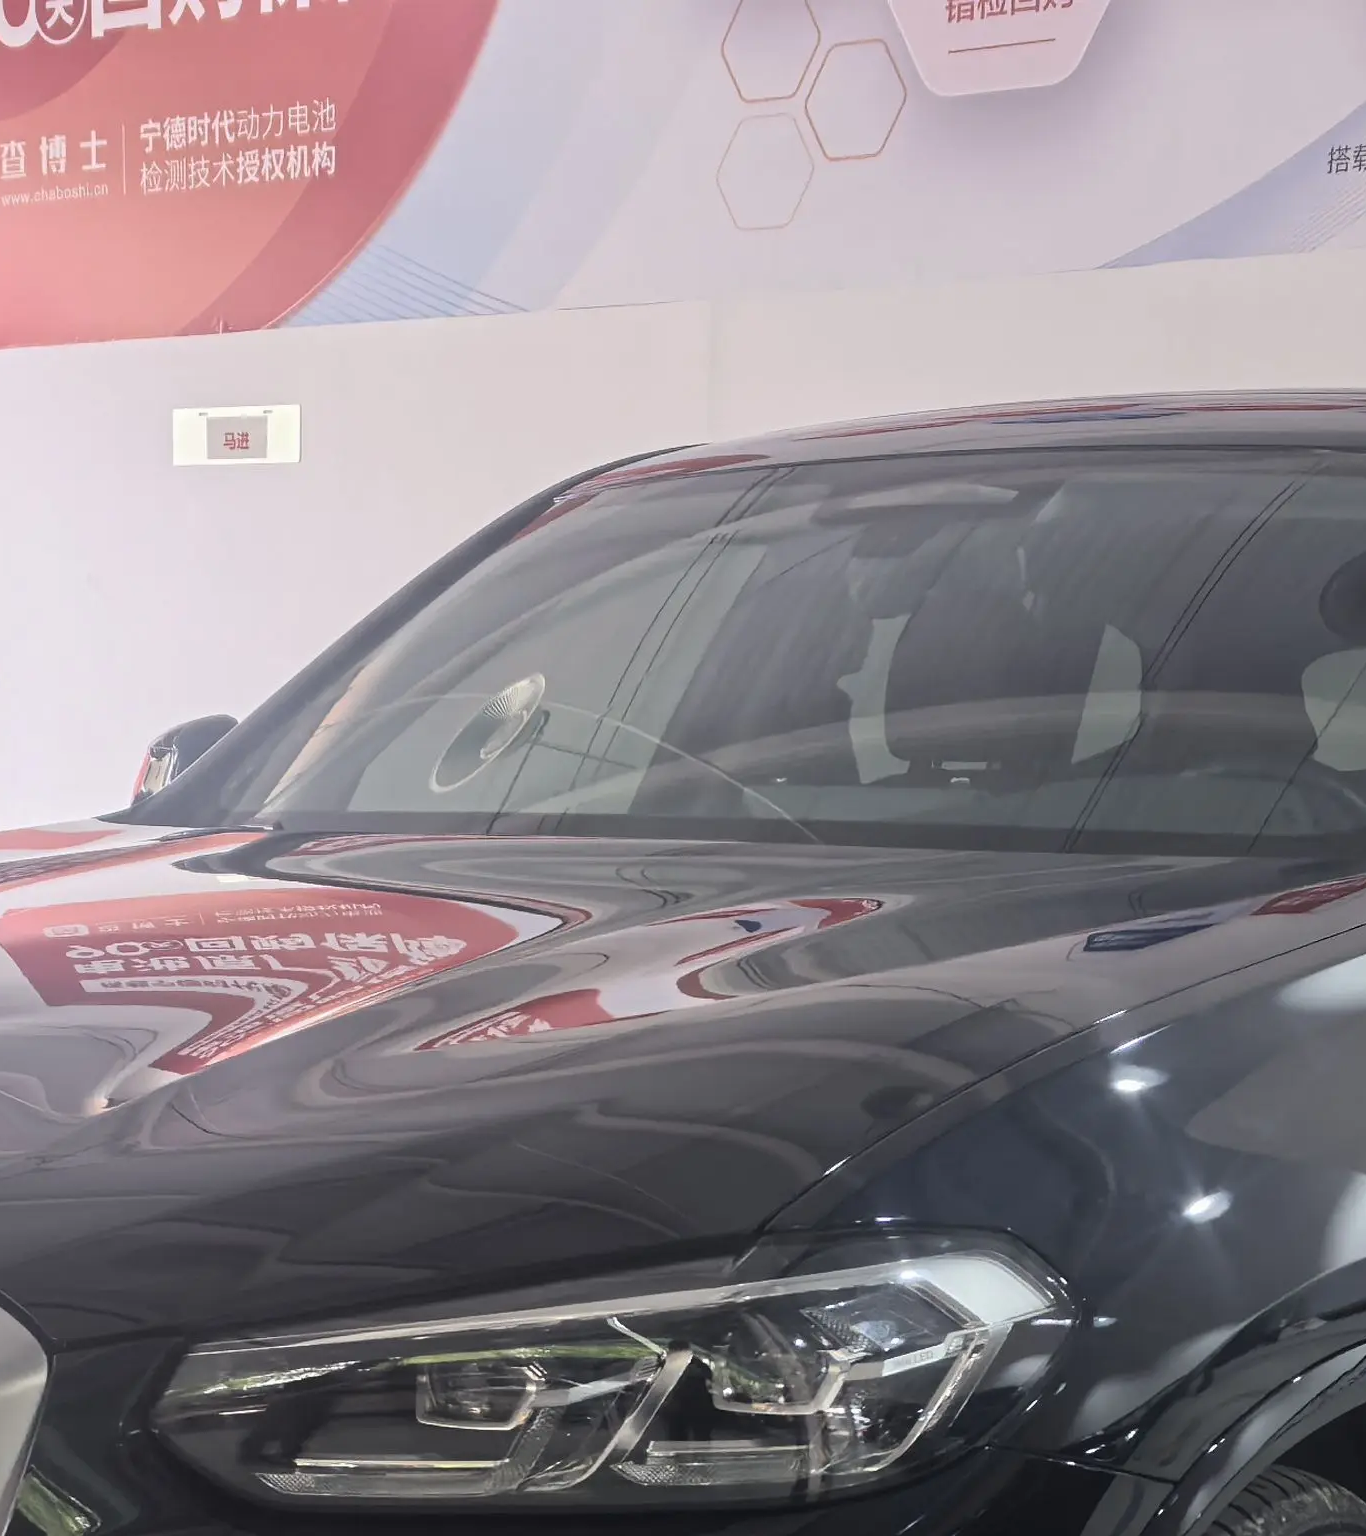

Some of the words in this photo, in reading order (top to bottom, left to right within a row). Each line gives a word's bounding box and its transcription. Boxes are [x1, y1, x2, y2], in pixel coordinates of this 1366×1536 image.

[140, 97, 336, 154] 宁德时代动力电池
[1, 182, 109, 207] www.chaboshi.cn
[140, 142, 336, 196] 检测技术授权机构
